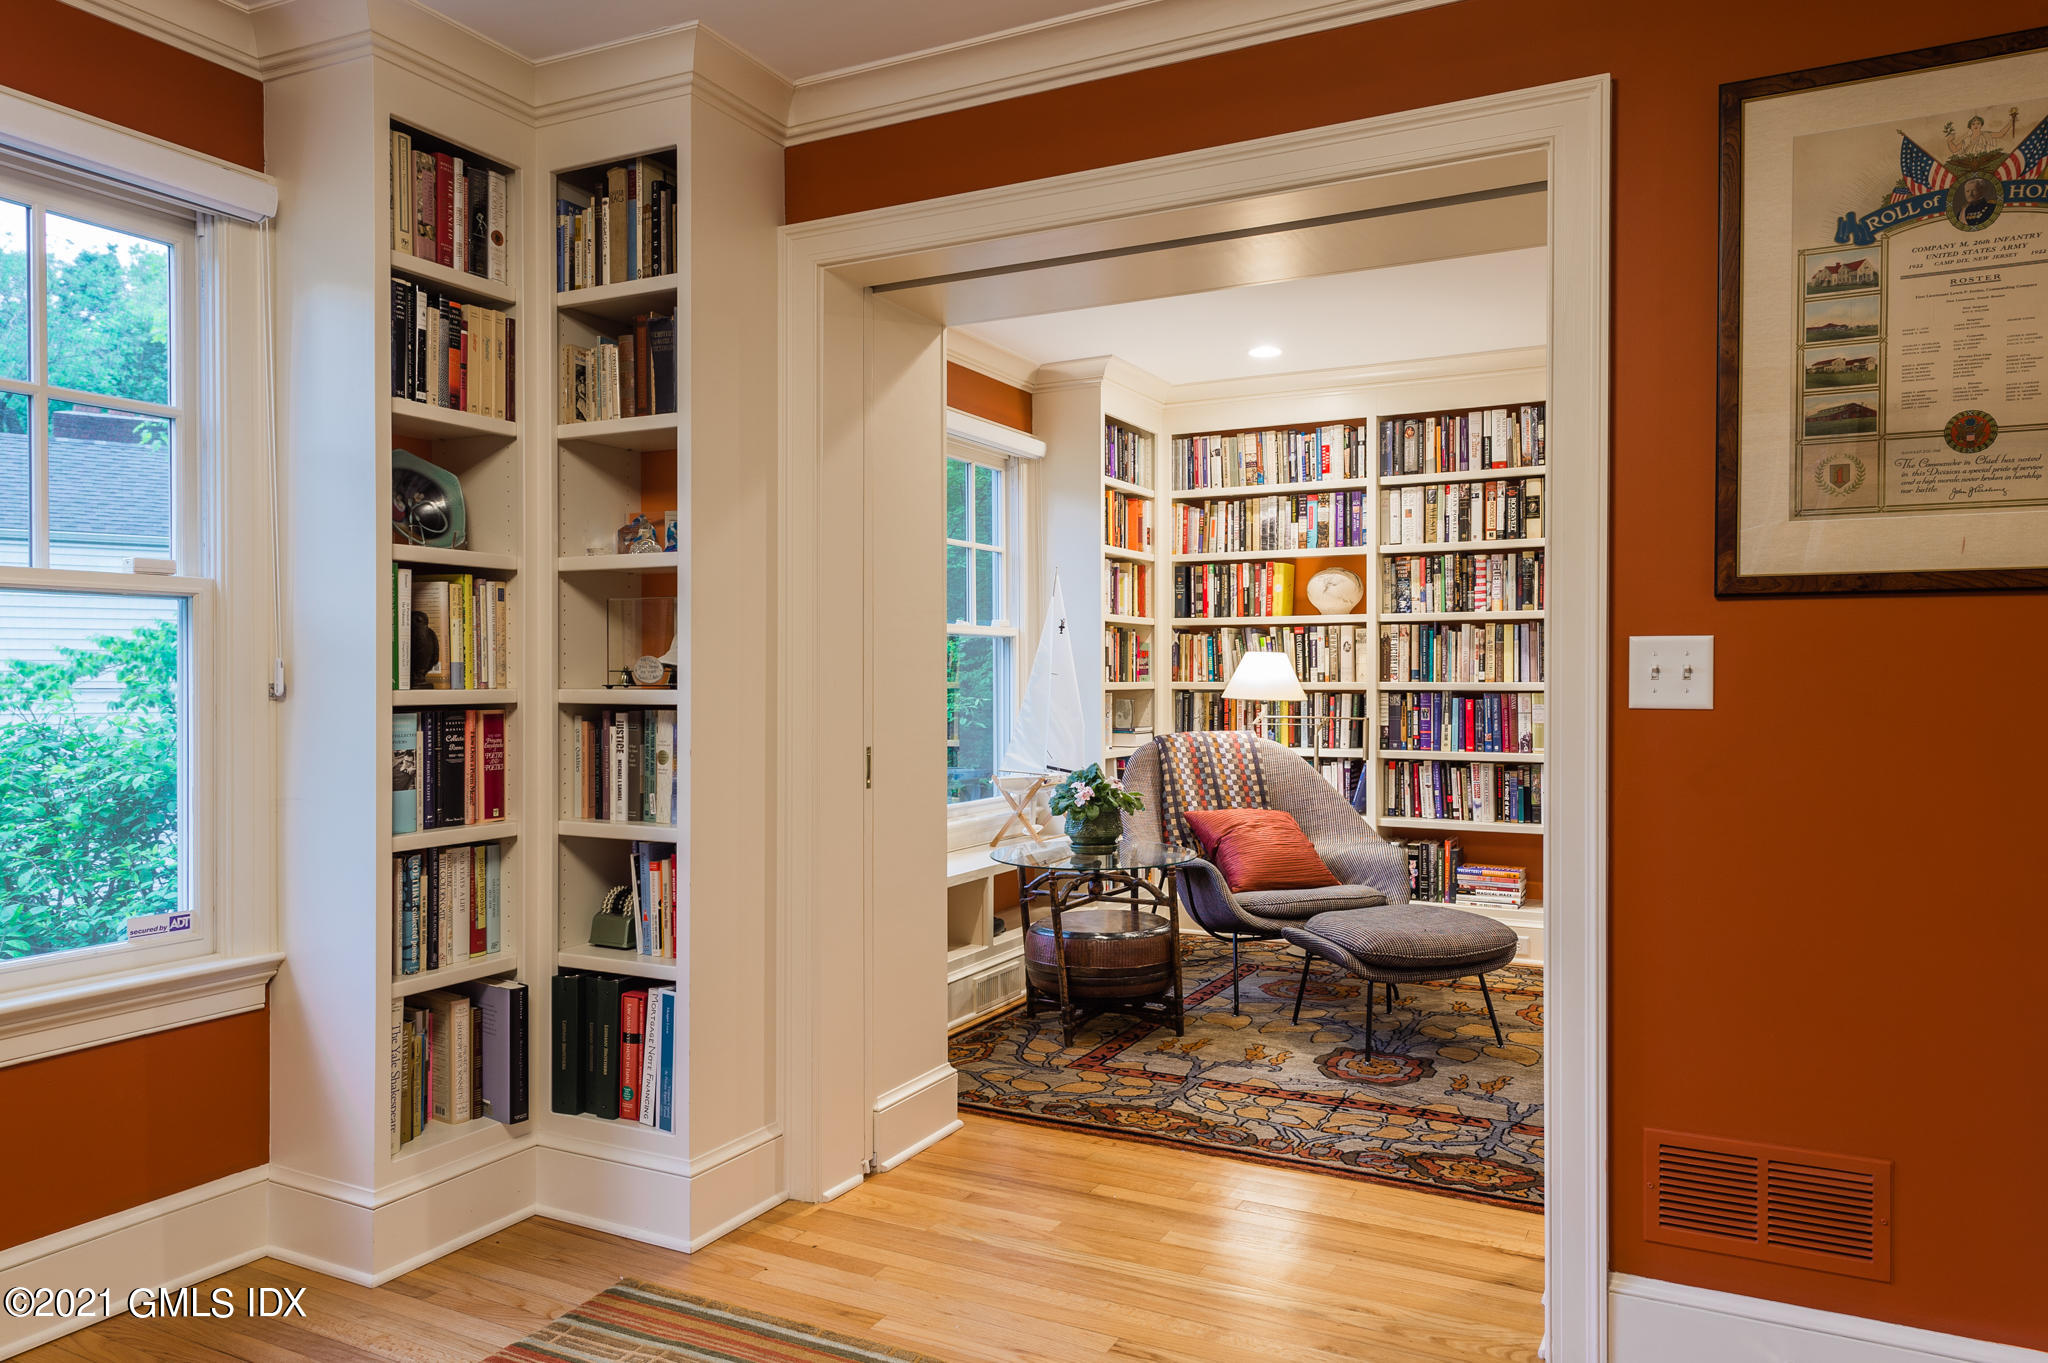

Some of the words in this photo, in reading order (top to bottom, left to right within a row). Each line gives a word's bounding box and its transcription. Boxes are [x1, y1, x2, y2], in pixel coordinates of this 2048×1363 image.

[1866, 204, 1920, 232] ROLL
[1922, 195, 1942, 209] of
[1912, 242, 1956, 254] COMPANY
[1994, 232, 2043, 244] INFANTRY
[1926, 250, 1958, 260] UNITED
[1962, 246, 1996, 256] STATES
[1999, 242, 2028, 252] ARMY
[1992, 252, 2018, 260] JERSEY
[1950, 274, 2001, 285] ROSTER
[1894, 458, 1916, 469] The
[1918, 458, 1962, 468] Commander
[1974, 454, 2000, 464] Chief
[2001, 454, 2015, 463] has
[2018, 454, 2042, 462] noted
[1912, 469, 1925, 477] this
[1926, 468, 1960, 476] Division
[1968, 465, 1990, 476] special
[1992, 464, 2011, 474] pride
[1922, 477, 1937, 486] high
[2013, 471, 2042, 480] hardship
[616, 720, 624, 754] JUSTICE
[130, 926, 158, 935] secured
[171, 917, 190, 928] ADT
[648, 994, 659, 1043] MORTGAGE
[391, 1022, 400, 1045] The
[391, 1045, 400, 1066] Yale
[647, 1045, 656, 1070] NOTE
[391, 1066, 401, 1133] Shakespeare
[643, 1073, 654, 1119] FINANCING
